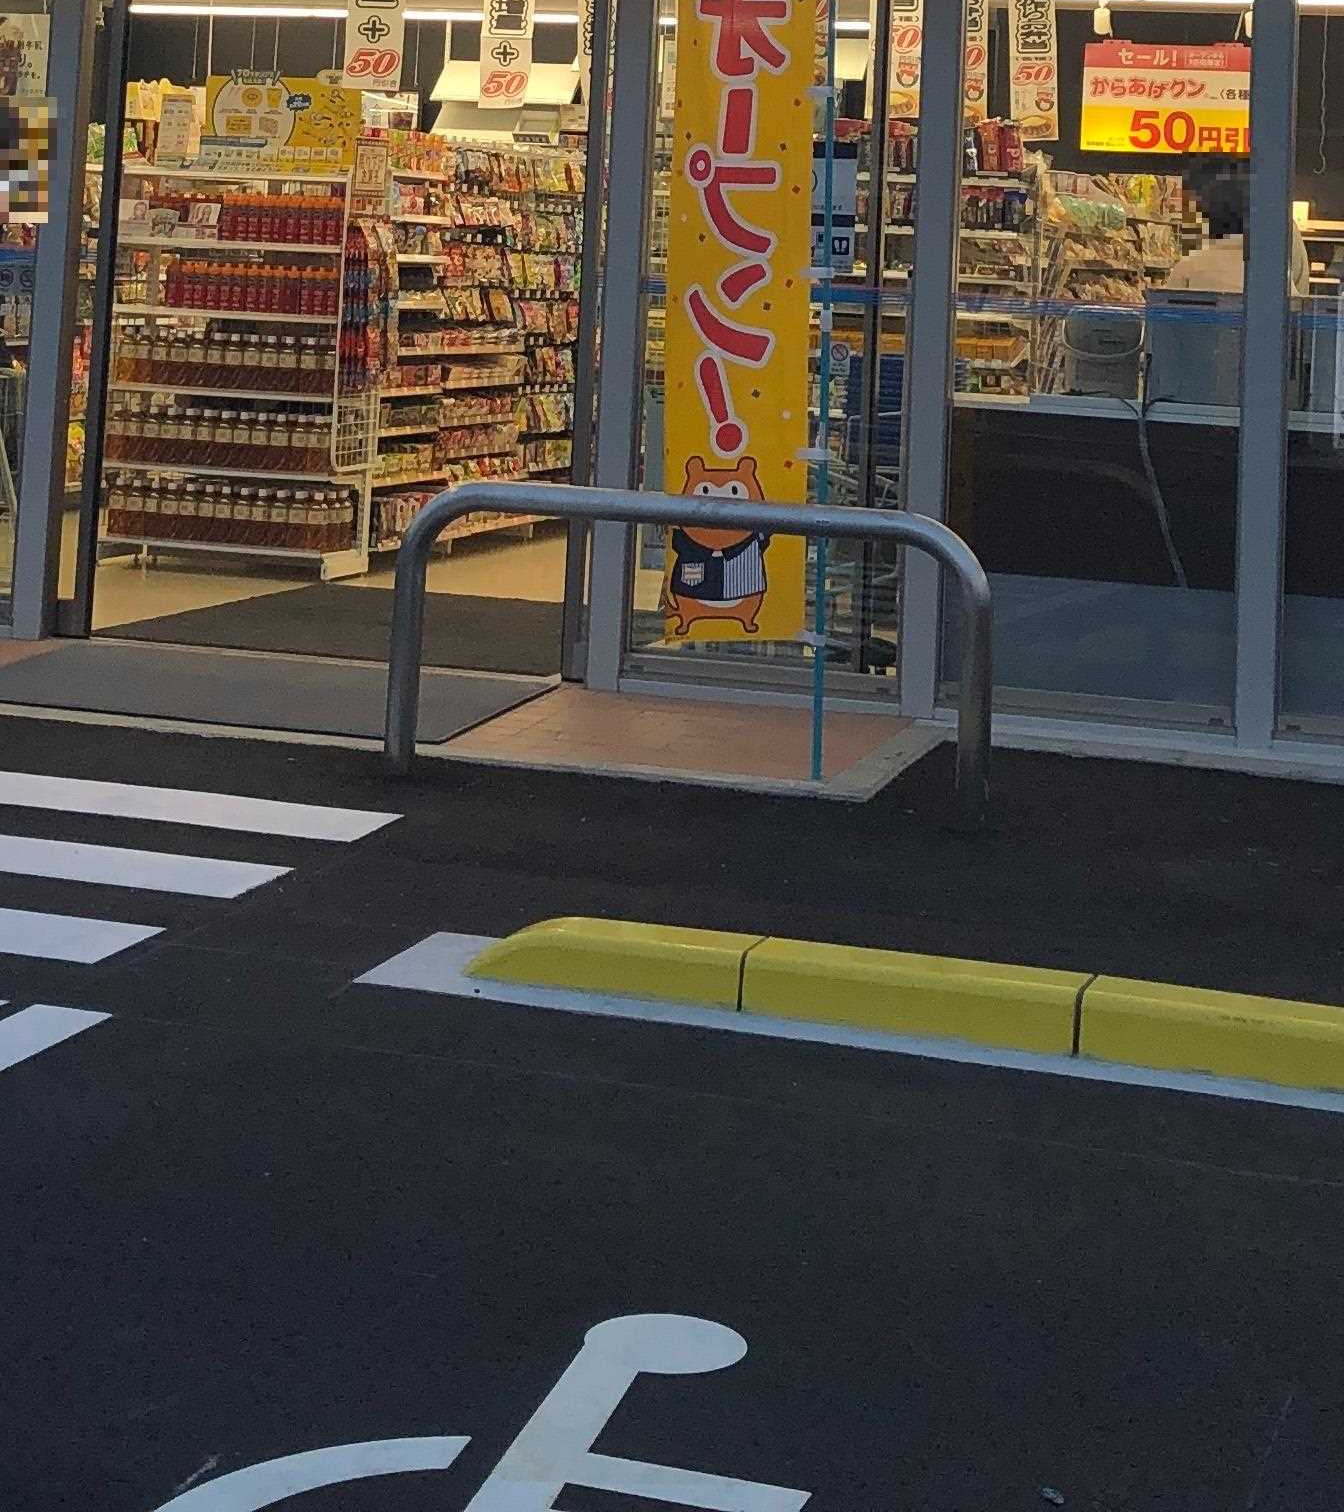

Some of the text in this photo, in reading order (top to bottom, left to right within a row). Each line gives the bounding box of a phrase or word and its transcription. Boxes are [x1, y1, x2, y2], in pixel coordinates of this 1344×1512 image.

[346, 48, 400, 78] 50
[1117, 47, 1178, 67] セール!
[481, 71, 528, 97] 50
[1013, 63, 1054, 85] 50
[1091, 76, 1206, 100] からあげクン
